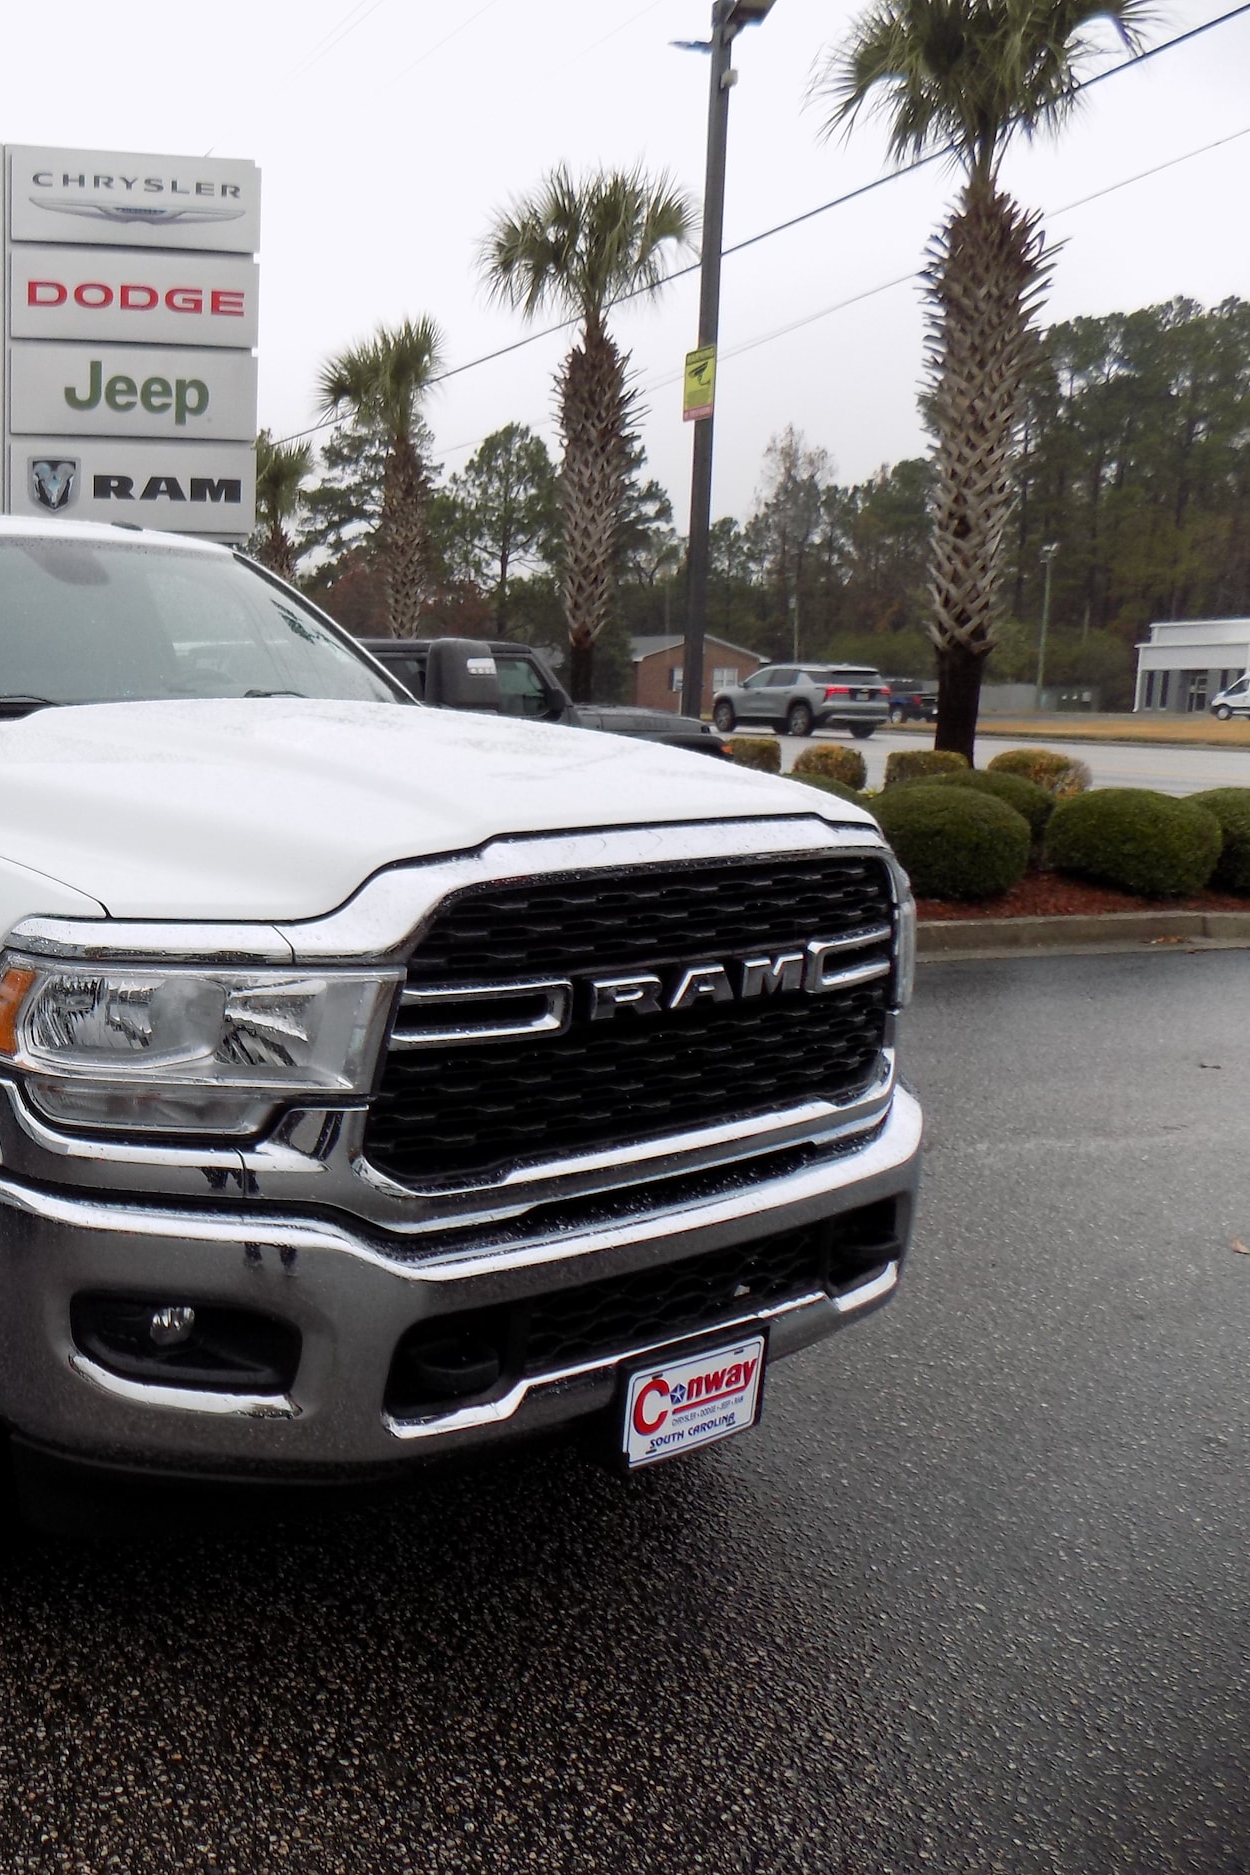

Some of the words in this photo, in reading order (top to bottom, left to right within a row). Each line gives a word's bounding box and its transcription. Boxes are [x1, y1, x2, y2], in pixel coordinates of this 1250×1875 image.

[31, 172, 242, 199] CHRYSLER
[27, 280, 246, 317] DODGE
[63, 360, 210, 426] Jeep
[92, 474, 242, 504] RAM
[590, 952, 805, 1021] RAM
[649, 1430, 685, 1450] SOUTH
[688, 1412, 736, 1437] CAROLINA
